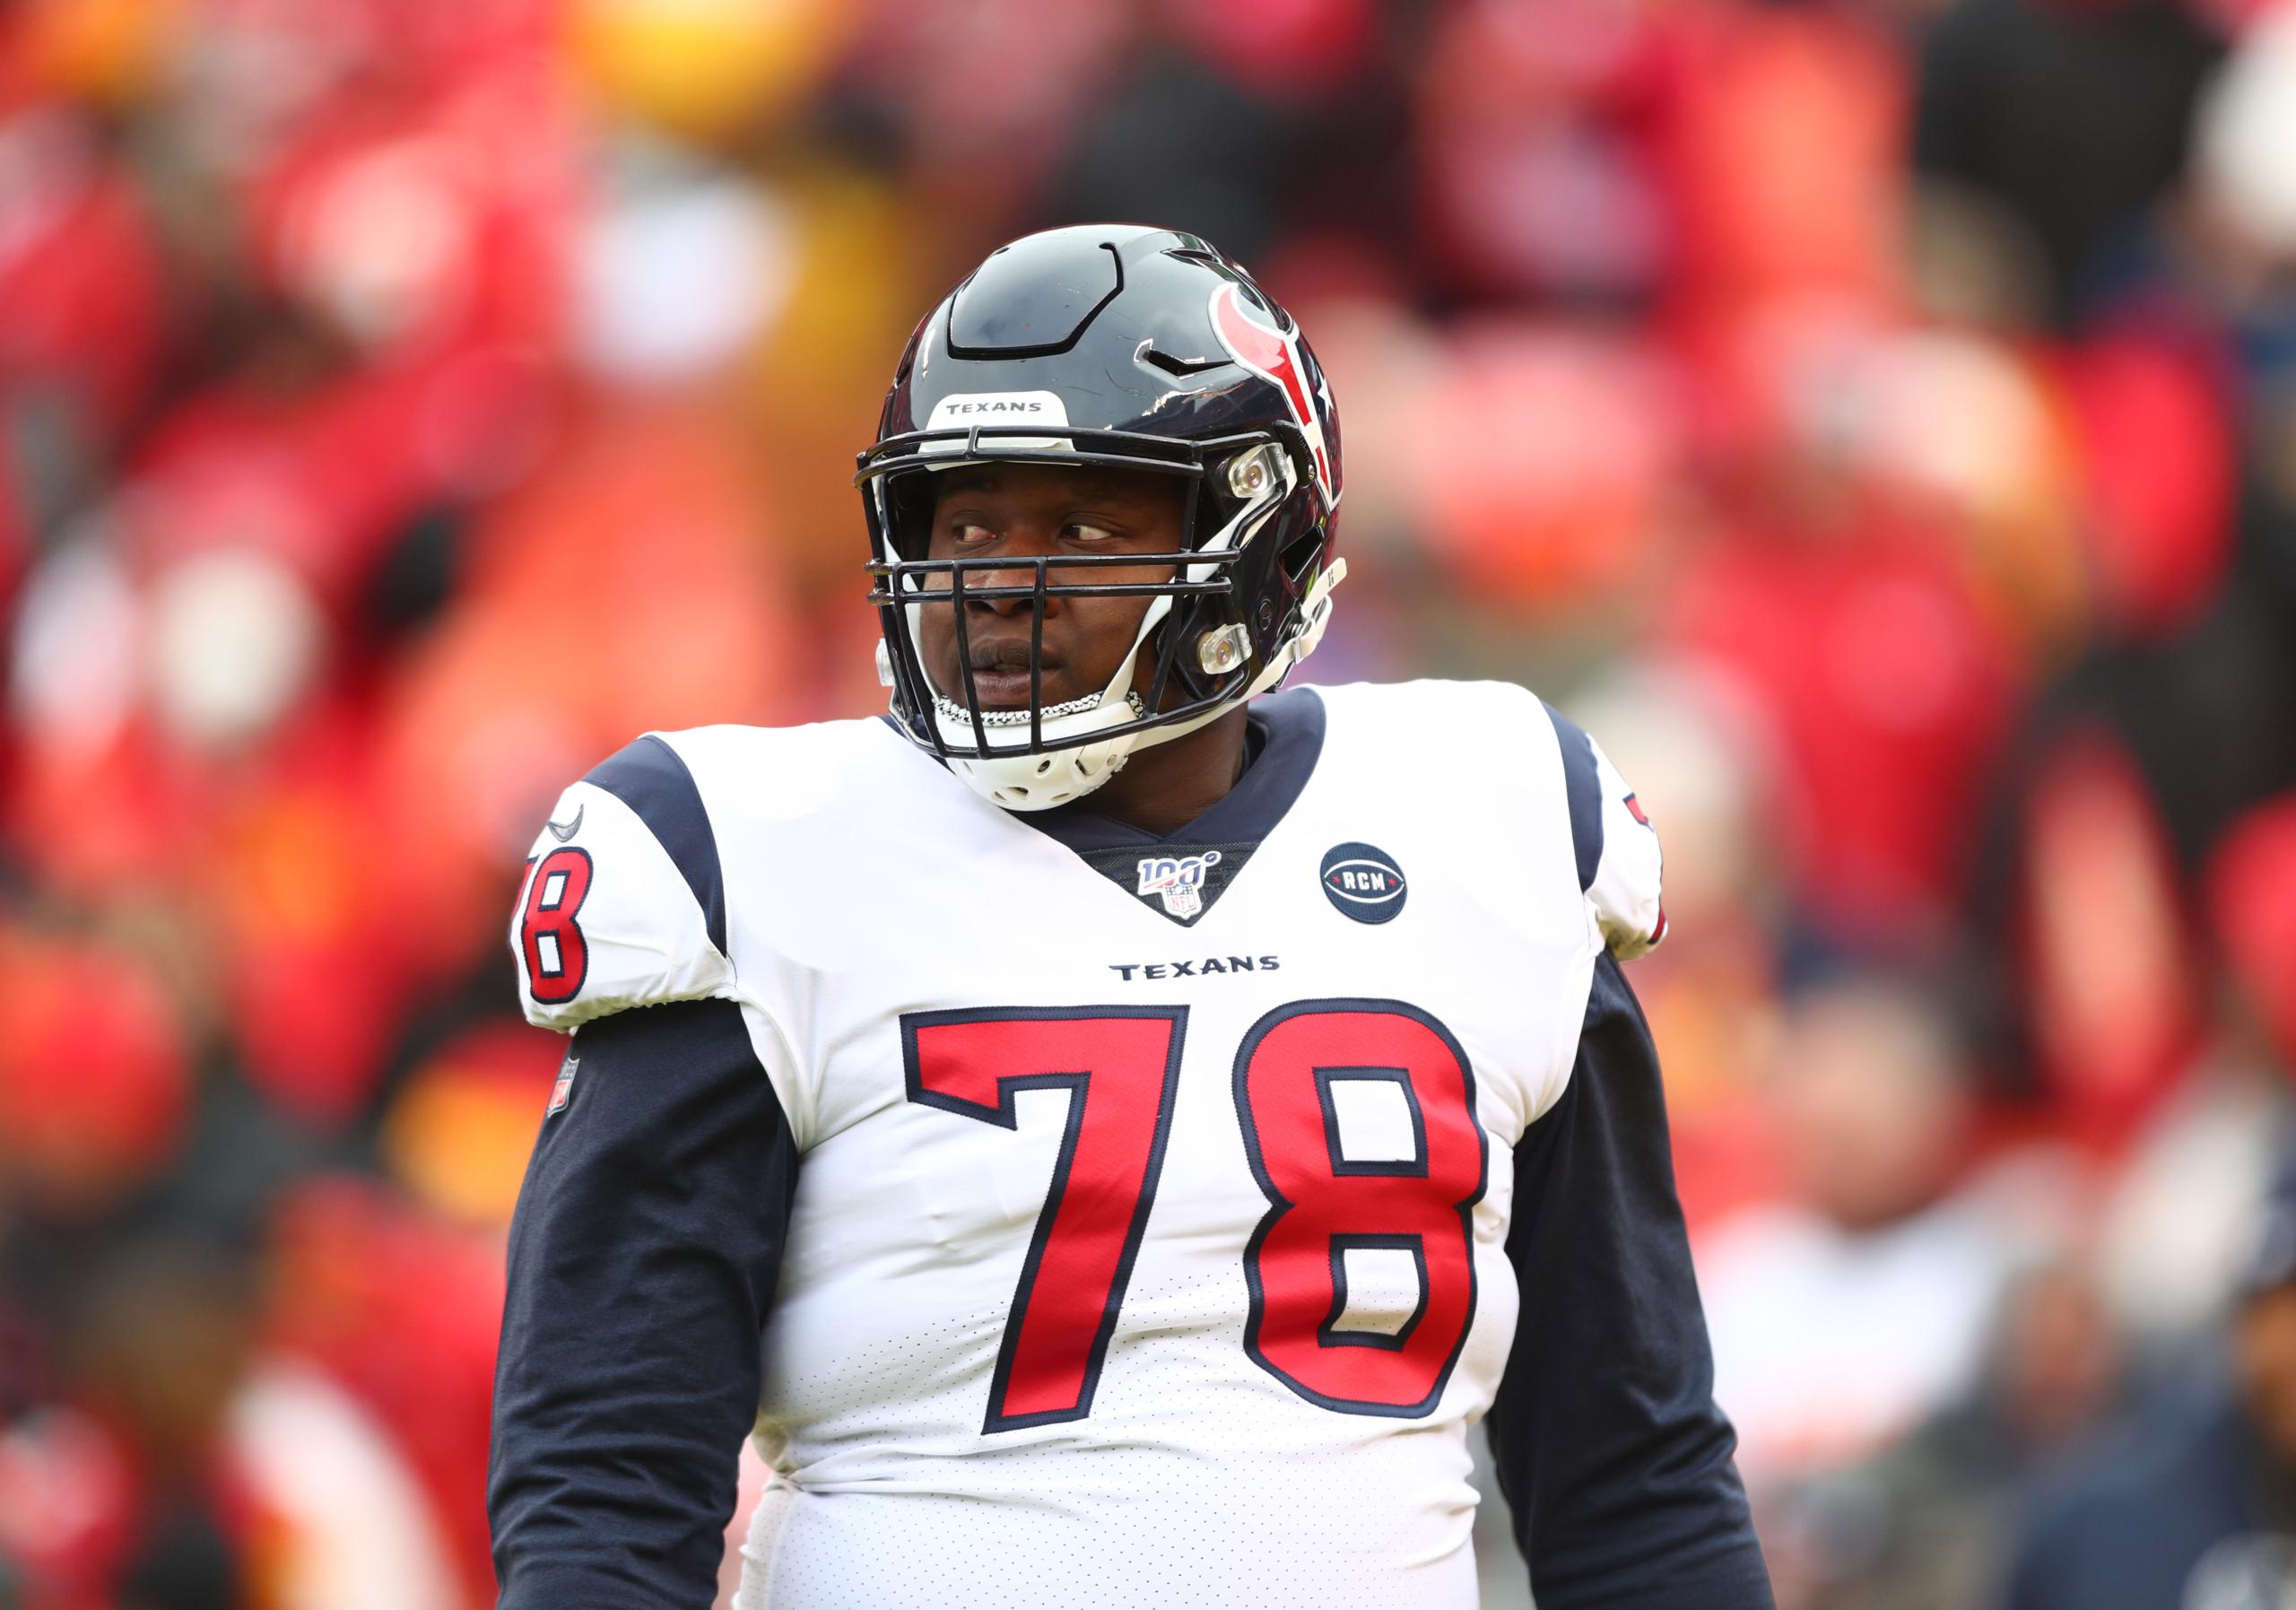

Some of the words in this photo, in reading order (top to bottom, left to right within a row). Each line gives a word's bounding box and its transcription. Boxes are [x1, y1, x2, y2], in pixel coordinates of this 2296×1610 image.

[945, 402, 1042, 415] TEXANS
[1343, 871, 1386, 891] RCM
[1170, 896, 1195, 909] NFL
[1108, 955, 1280, 981] TEXANS
[899, 997, 1489, 1435] 78
